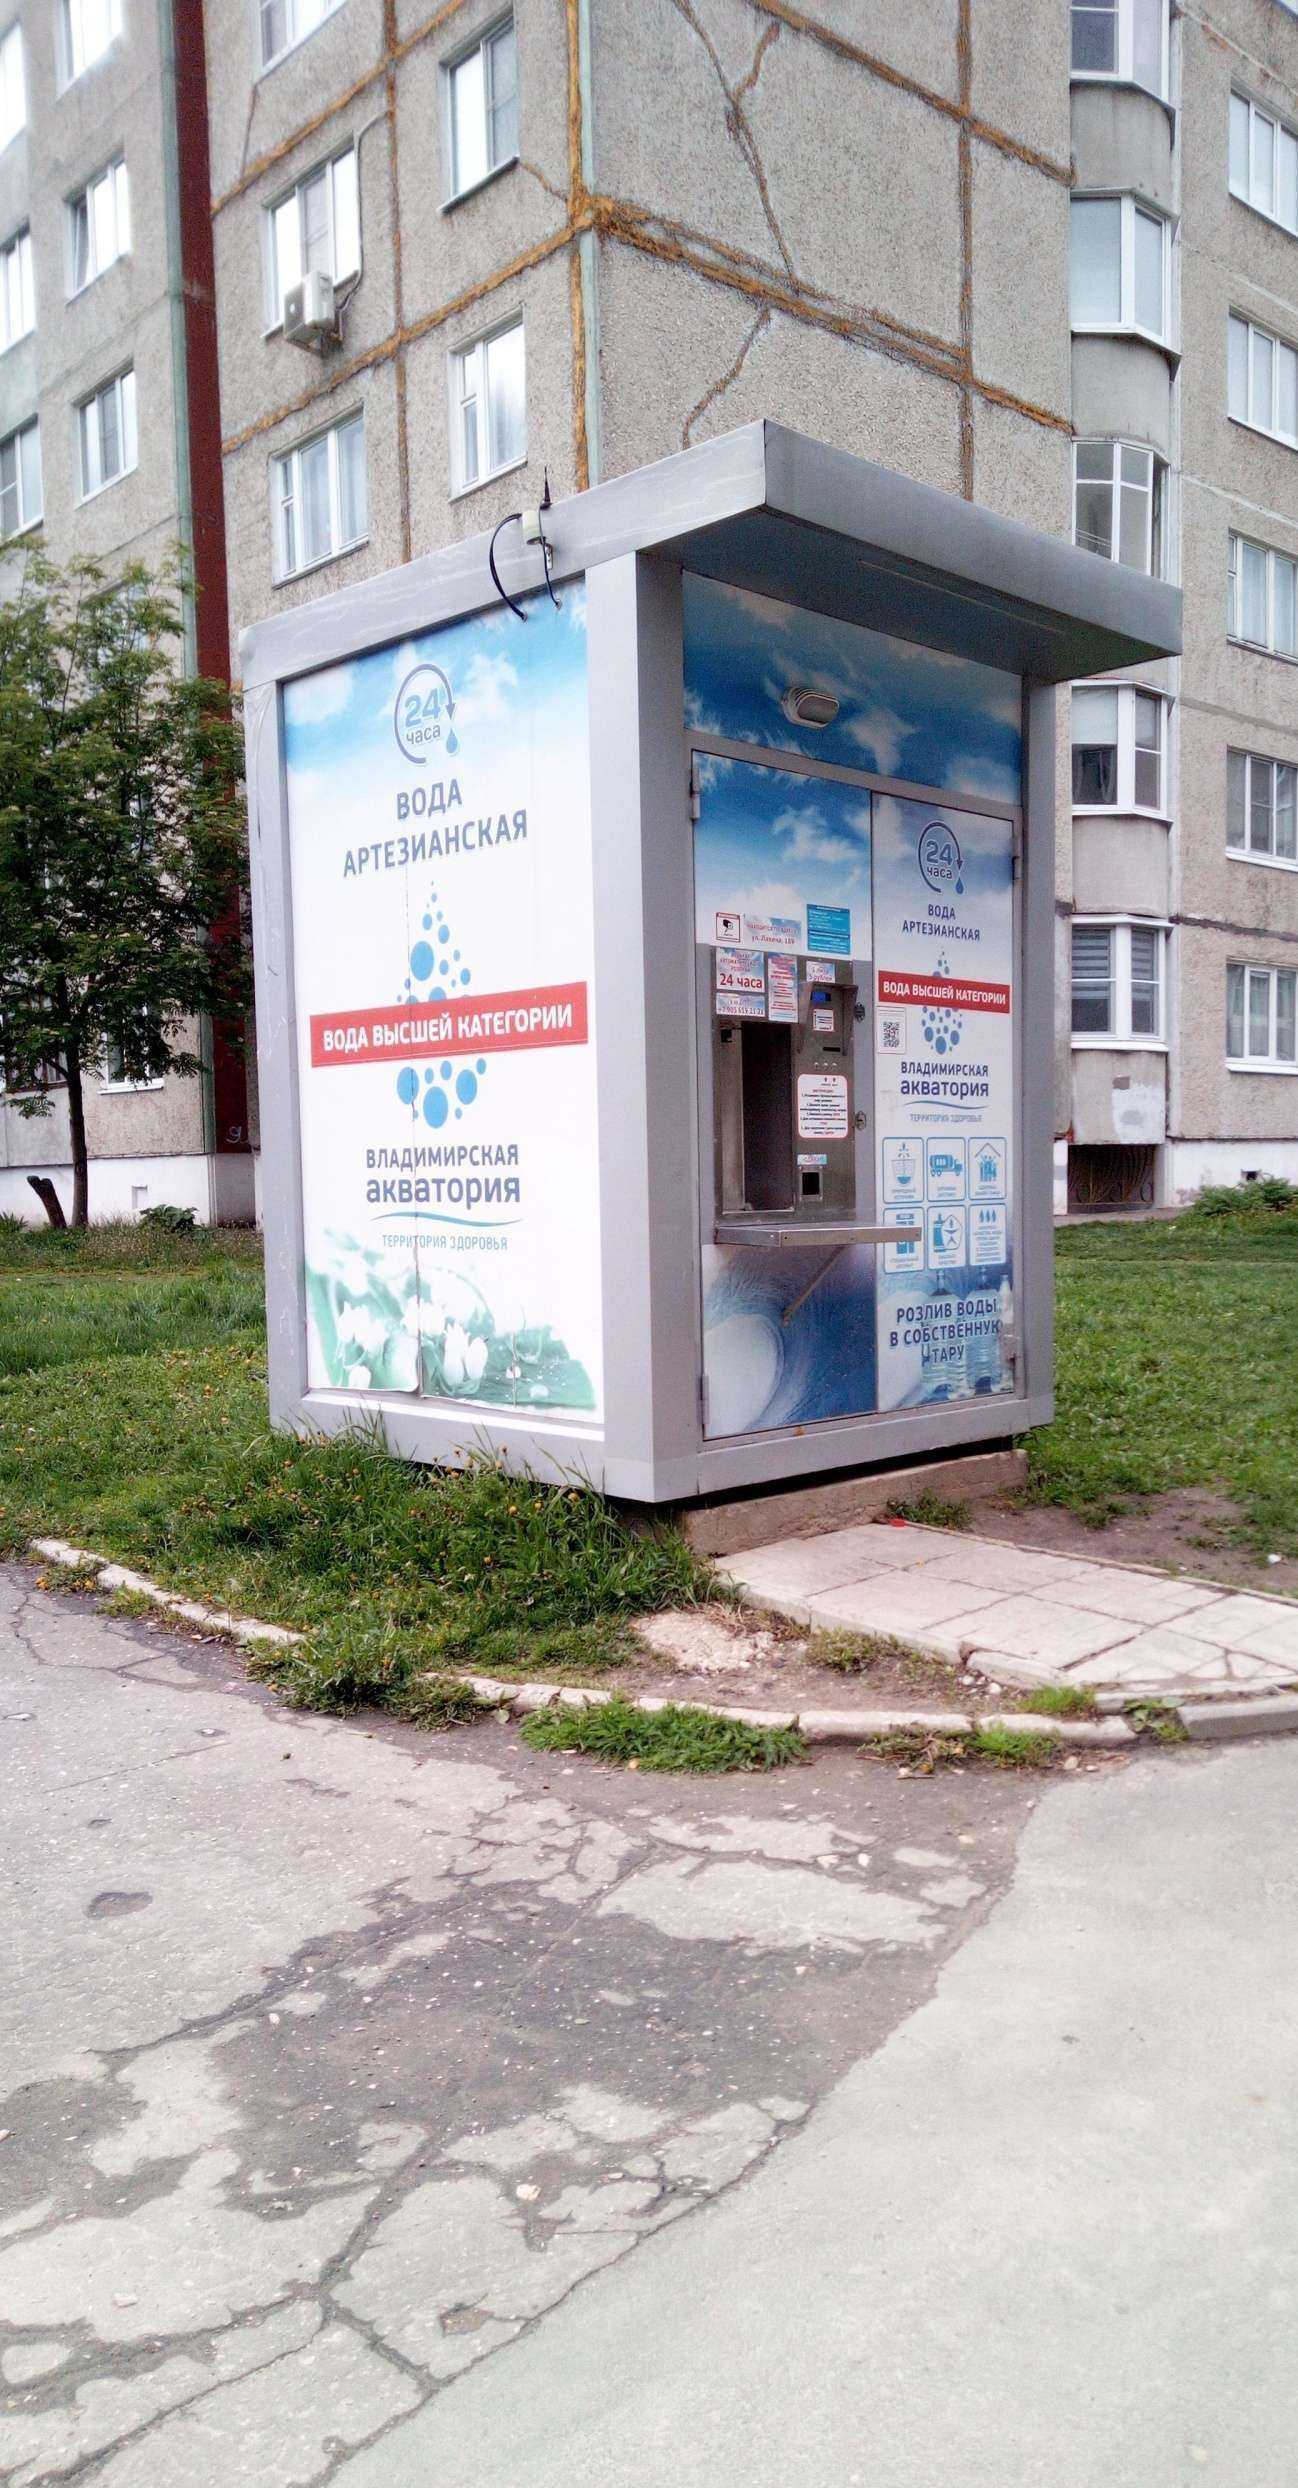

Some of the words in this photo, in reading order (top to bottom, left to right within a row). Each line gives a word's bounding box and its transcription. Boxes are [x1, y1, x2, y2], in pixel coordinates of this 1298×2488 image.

[404, 688, 441, 728] 24
[406, 725, 441, 746] часа
[396, 778, 463, 820] ВОДА
[343, 808, 528, 878] АРТЕЗИАНСКАЯ
[926, 840, 952, 866] 24
[927, 866, 952, 879] часа
[928, 903, 956, 921] ВОДА
[902, 919, 981, 942] АРТЕЗИАНСКАЯ
[720, 973, 733, 987] 24
[737, 976, 763, 989] часа
[883, 981, 910, 996] ВОДА
[912, 985, 954, 999] ВЫСШЕЙ
[956, 989, 1006, 1005] КАТЕГОРИИ
[323, 1026, 368, 1053] ВОДА
[372, 1013, 453, 1047] ВЫСШЕЙ
[457, 1003, 573, 1039] КАТЕГОРИИ
[901, 1061, 989, 1077] ВЛАДИМИРСКАЯ
[900, 1080, 989, 1100] акватория
[366, 1144, 519, 1172] ВЛАДИМИРСКАЯ
[366, 1177, 521, 1210] акватория
[382, 1234, 447, 1249] ТЕРРИТОРИЯ
[449, 1235, 508, 1251] ЗДОРОВЬЯ
[896, 1303, 952, 1323] РОЗЛИВ
[957, 1299, 997, 1317] ВОДЫ
[890, 1331, 899, 1347] В
[904, 1318, 1004, 1345] СОБСТВЕННУЮ
[932, 1344, 965, 1363] ТАРУ
